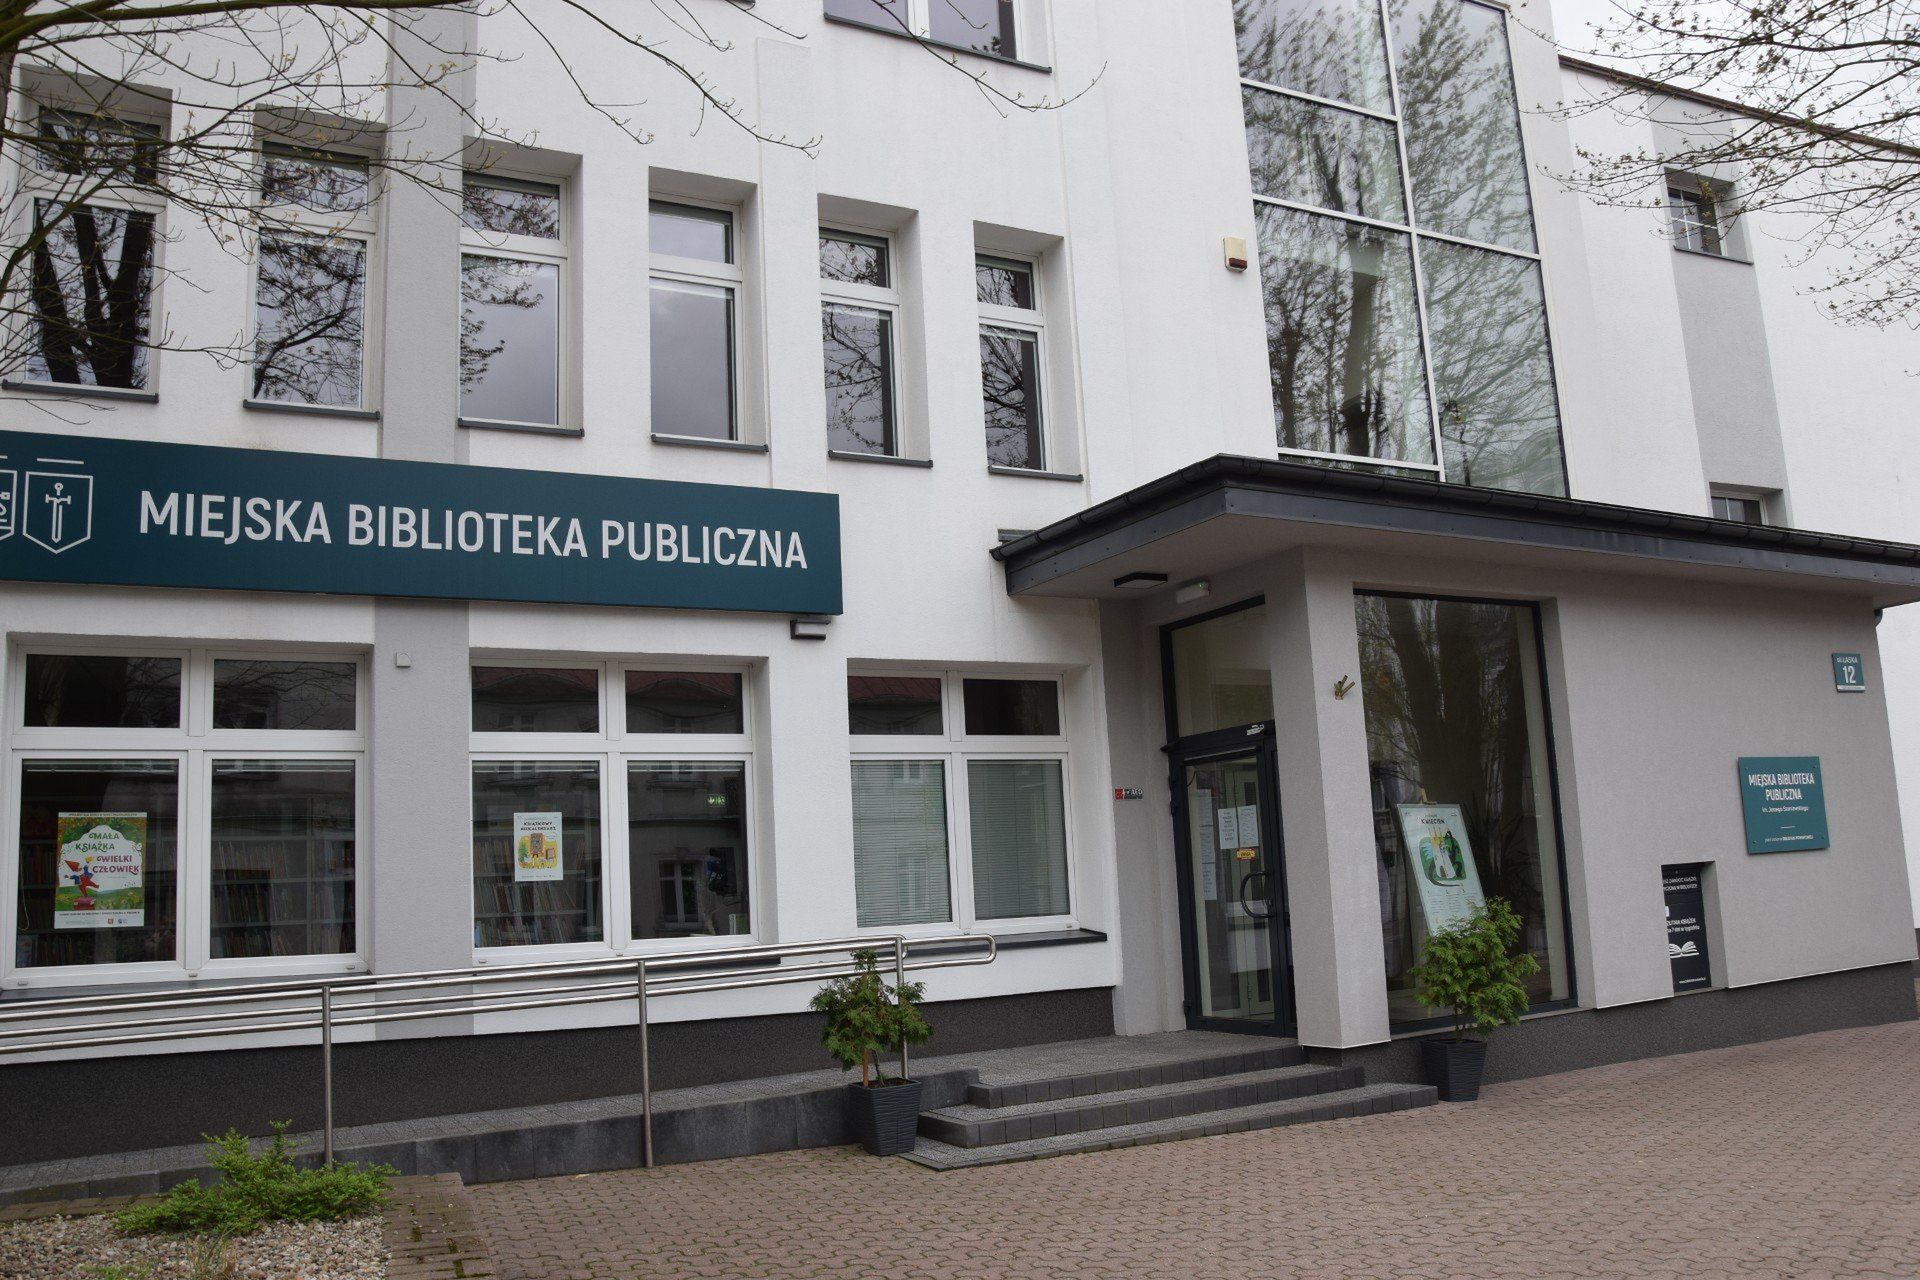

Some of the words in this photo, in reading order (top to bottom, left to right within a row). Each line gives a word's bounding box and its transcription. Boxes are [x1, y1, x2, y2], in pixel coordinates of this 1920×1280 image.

[139, 490, 332, 546] MIEJSKA
[347, 503, 589, 558] BIBLIOTEKA
[601, 519, 808, 570] PUBLICZNA
[1842, 665, 1857, 684] 12
[1748, 774, 1777, 787] MIEJSKA
[1777, 772, 1815, 785] BIBLIOTEKA
[1765, 788, 1803, 801] PUBLICZNA
[89, 832, 119, 840] MAŁA
[75, 840, 115, 853] KSIĄŻKA
[92, 865, 140, 875] CZŁOWIEK
